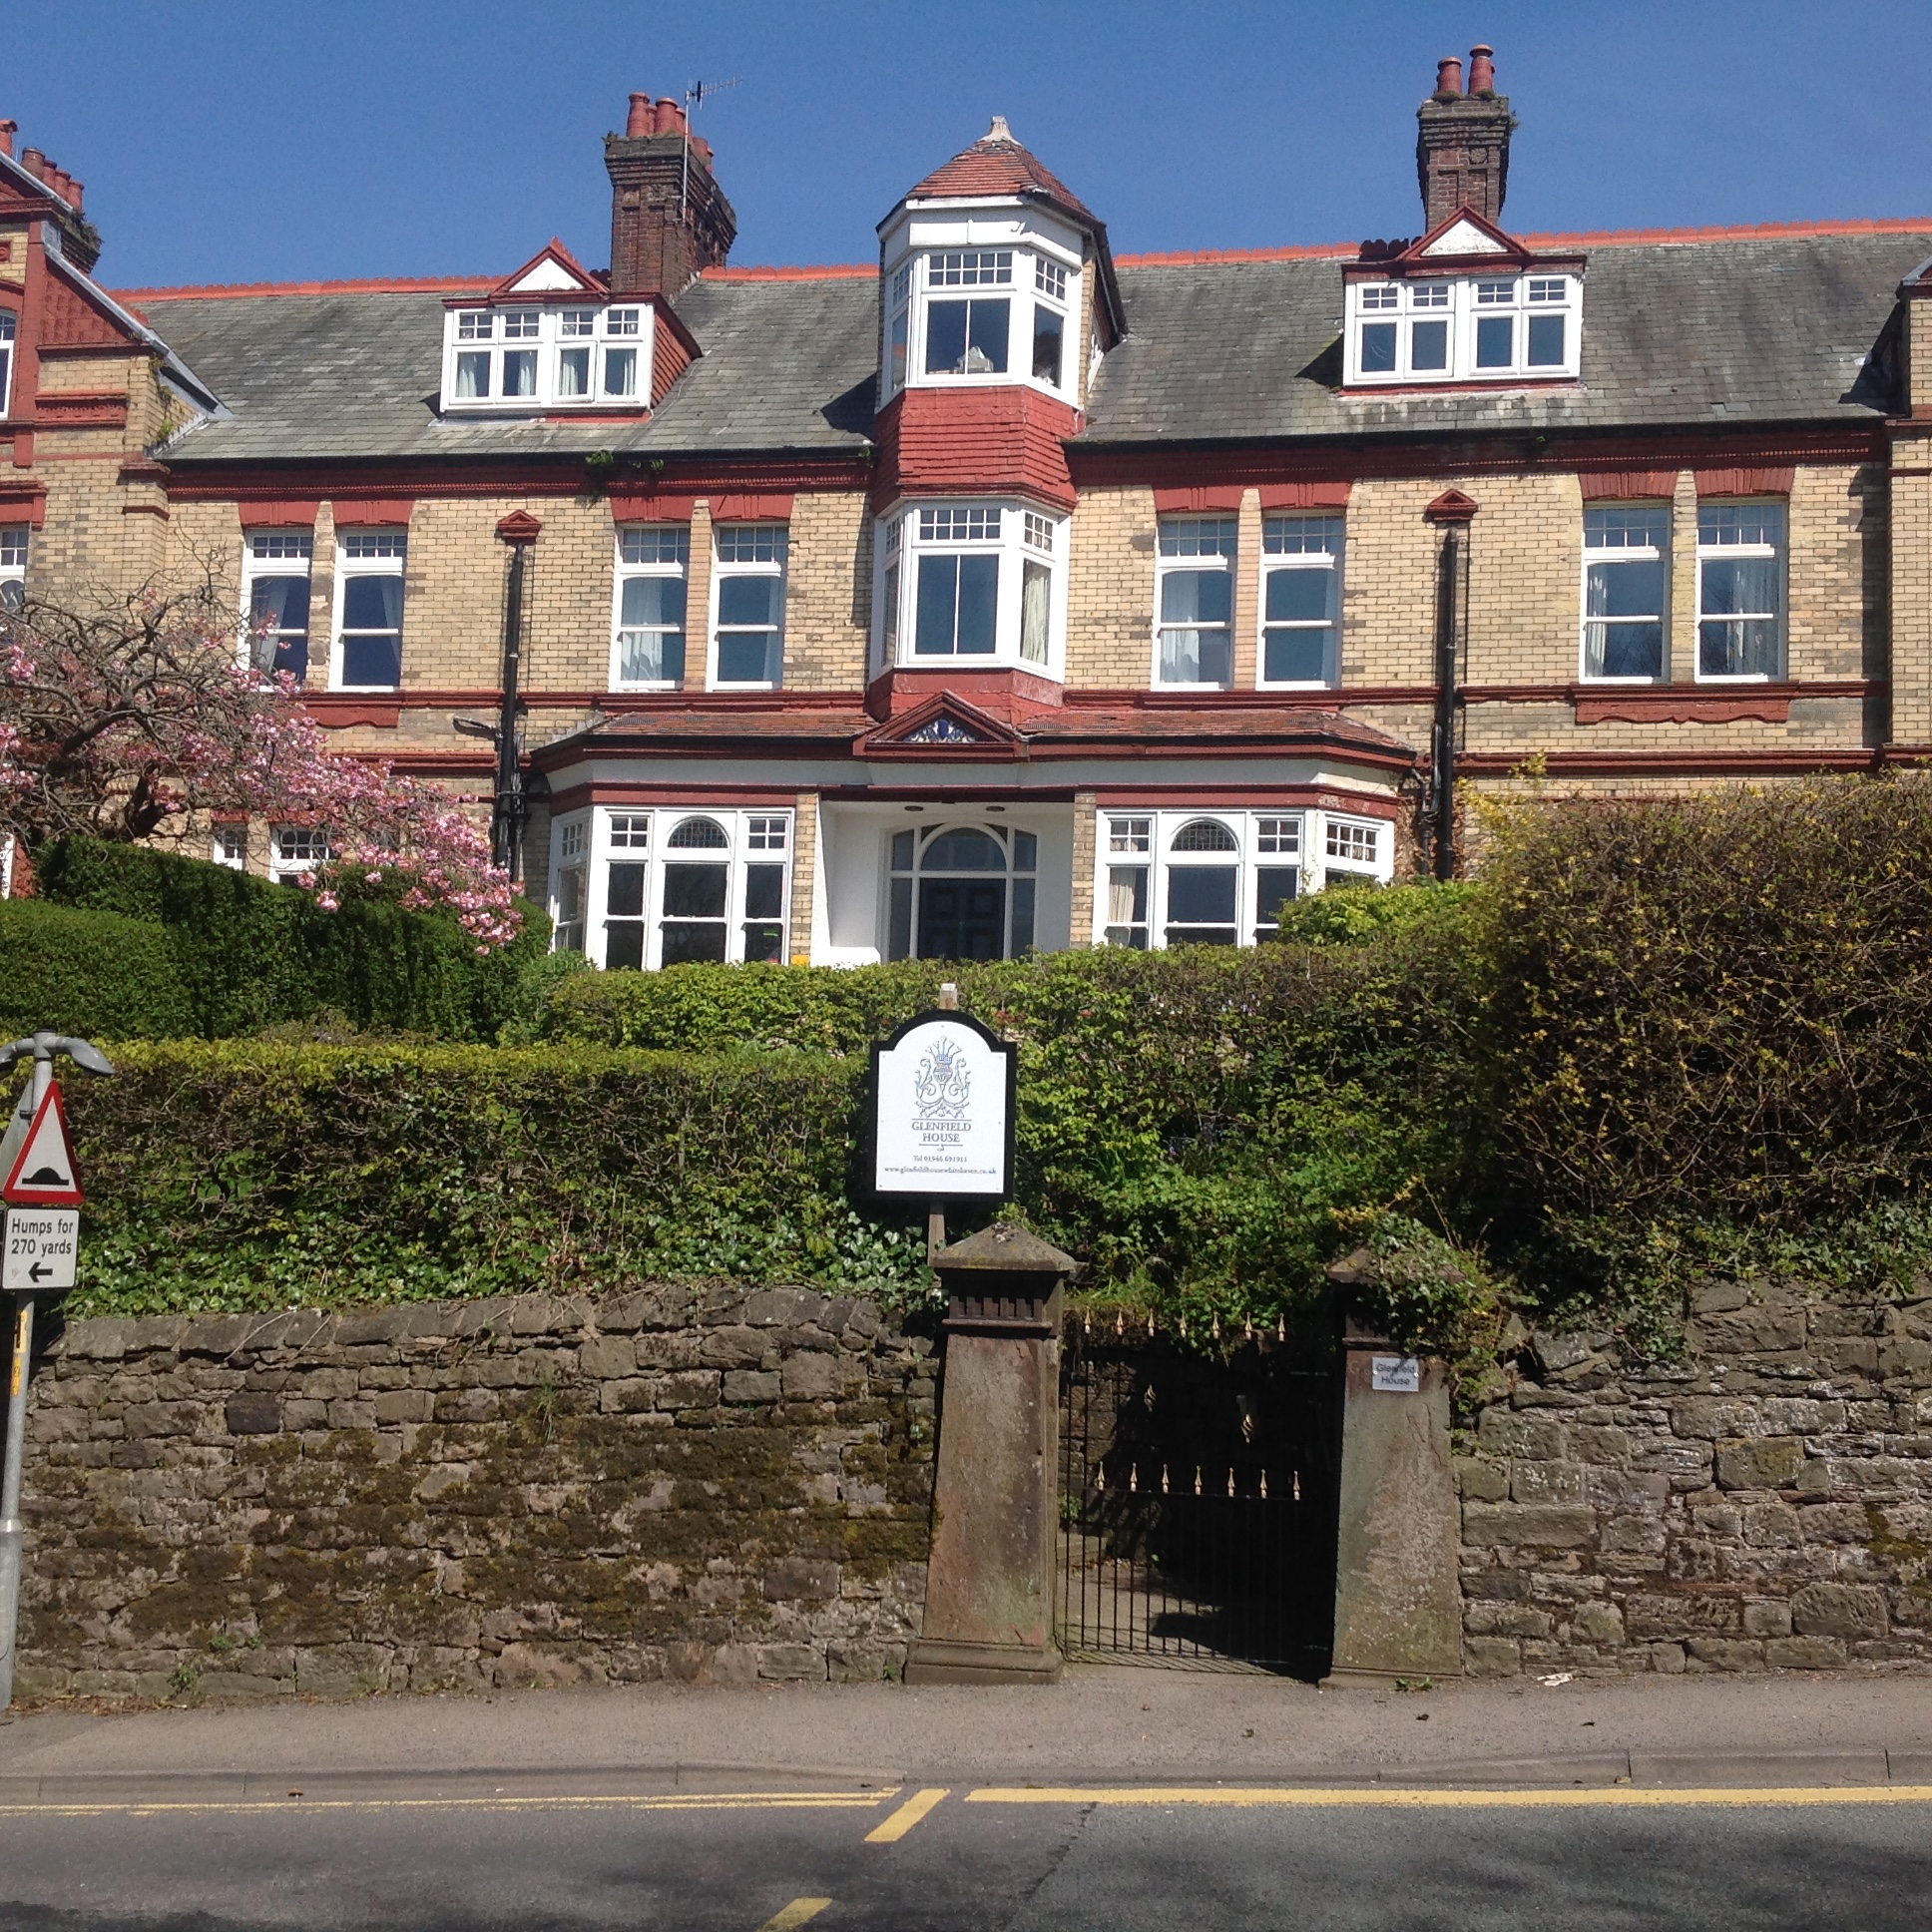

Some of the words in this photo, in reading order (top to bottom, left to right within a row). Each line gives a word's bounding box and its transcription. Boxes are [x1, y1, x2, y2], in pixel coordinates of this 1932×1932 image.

[911, 1121, 972, 1132] GLENFIELD
[922, 1133, 960, 1143] HOUSE
[11, 1217, 53, 1236] Humps
[57, 1217, 74, 1233] for
[11, 1237, 37, 1254] 270
[41, 1238, 72, 1258] yards
[1381, 1376, 1410, 1385] House
